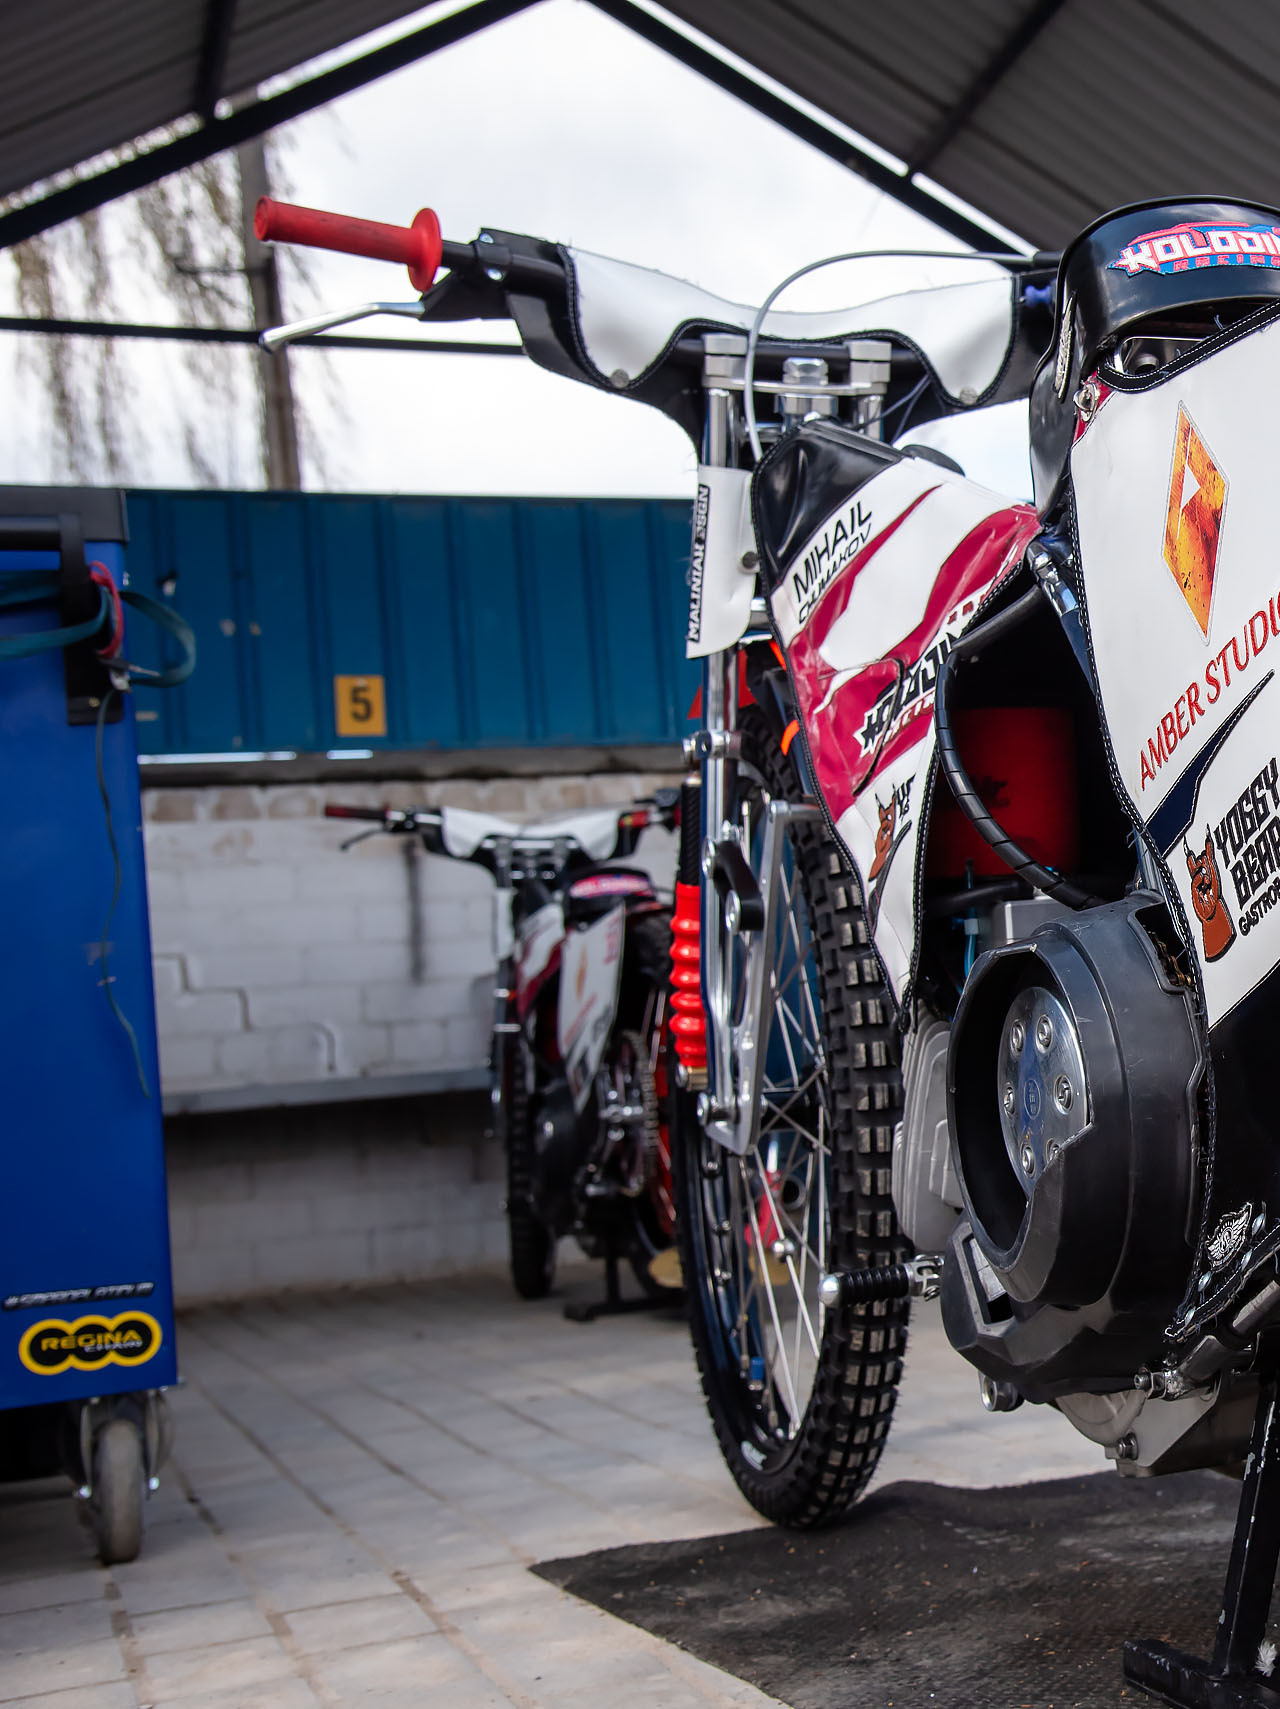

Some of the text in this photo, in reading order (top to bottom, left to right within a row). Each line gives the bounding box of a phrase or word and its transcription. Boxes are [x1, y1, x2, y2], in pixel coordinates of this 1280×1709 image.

[793, 501, 872, 604] MIHAIL
[351, 686, 373, 722] 5
[1139, 681, 1206, 792] AMBER
[41, 1329, 142, 1351] REGINA
